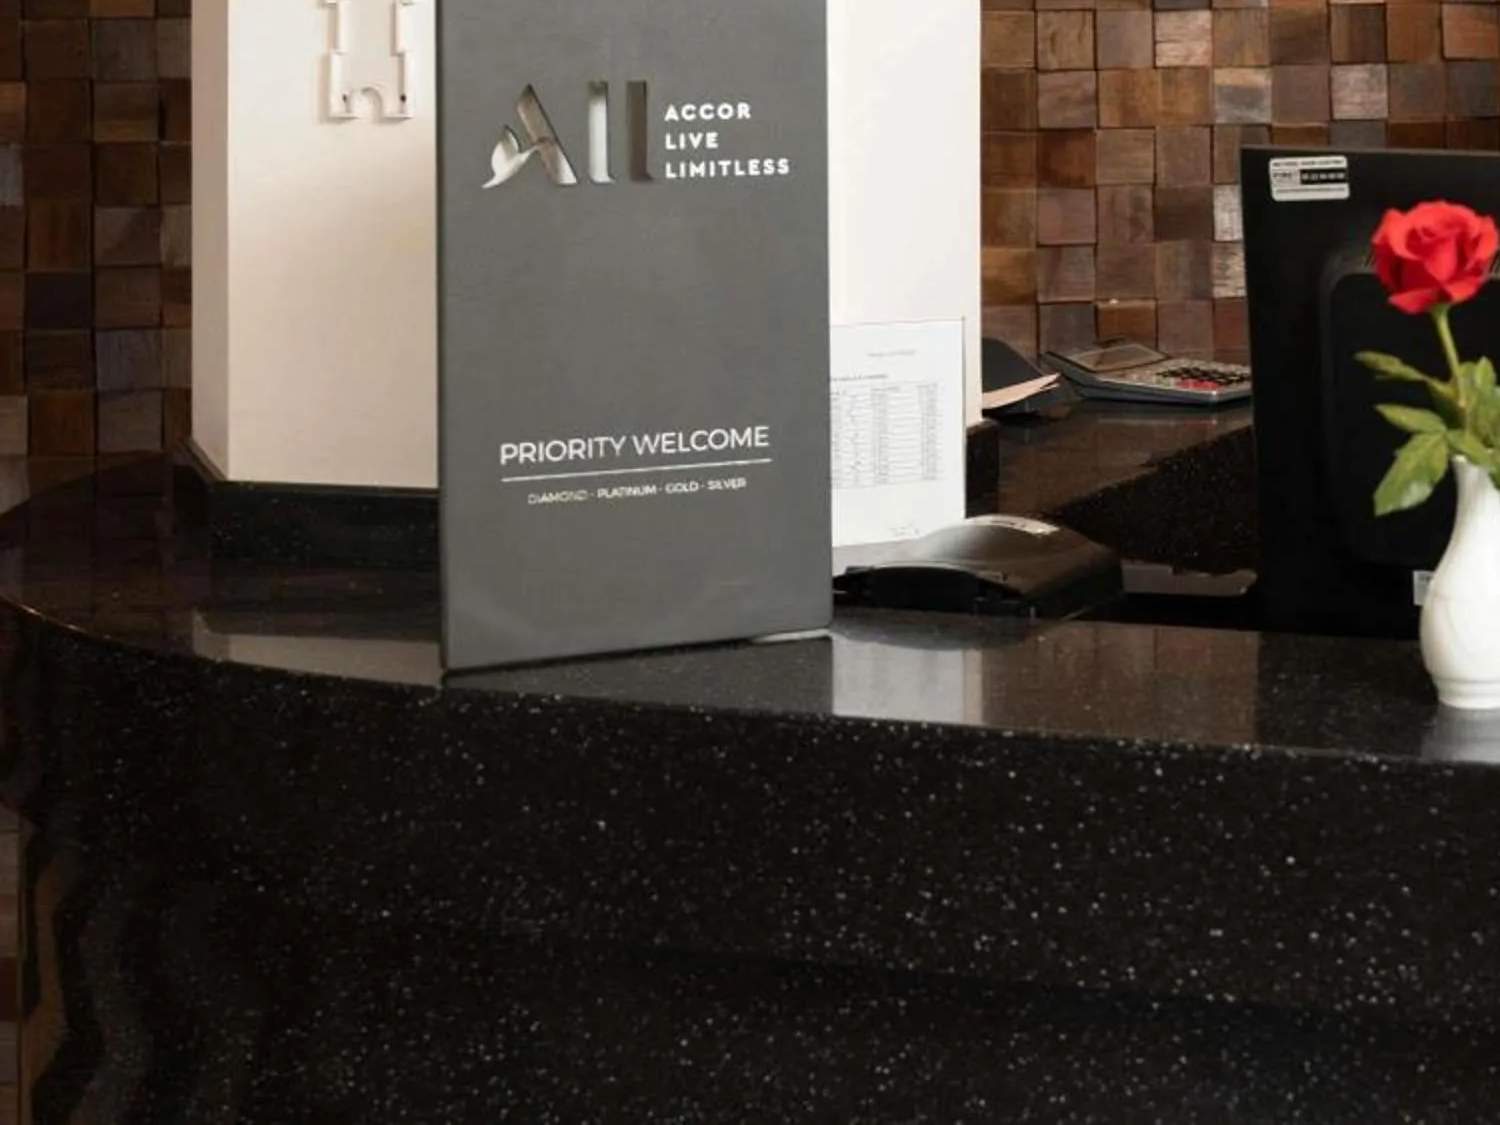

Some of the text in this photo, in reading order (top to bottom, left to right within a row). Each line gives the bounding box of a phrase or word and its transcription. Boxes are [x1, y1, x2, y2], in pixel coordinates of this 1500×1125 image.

[664, 102, 751, 121] ACCOR
[665, 132, 718, 150] LIVE
[665, 158, 789, 179] LIMITLESS
[500, 426, 770, 465] PRIORITY WELCOME
[528, 477, 747, 505] DIAMOND PLATINUM GOLD SILVER
